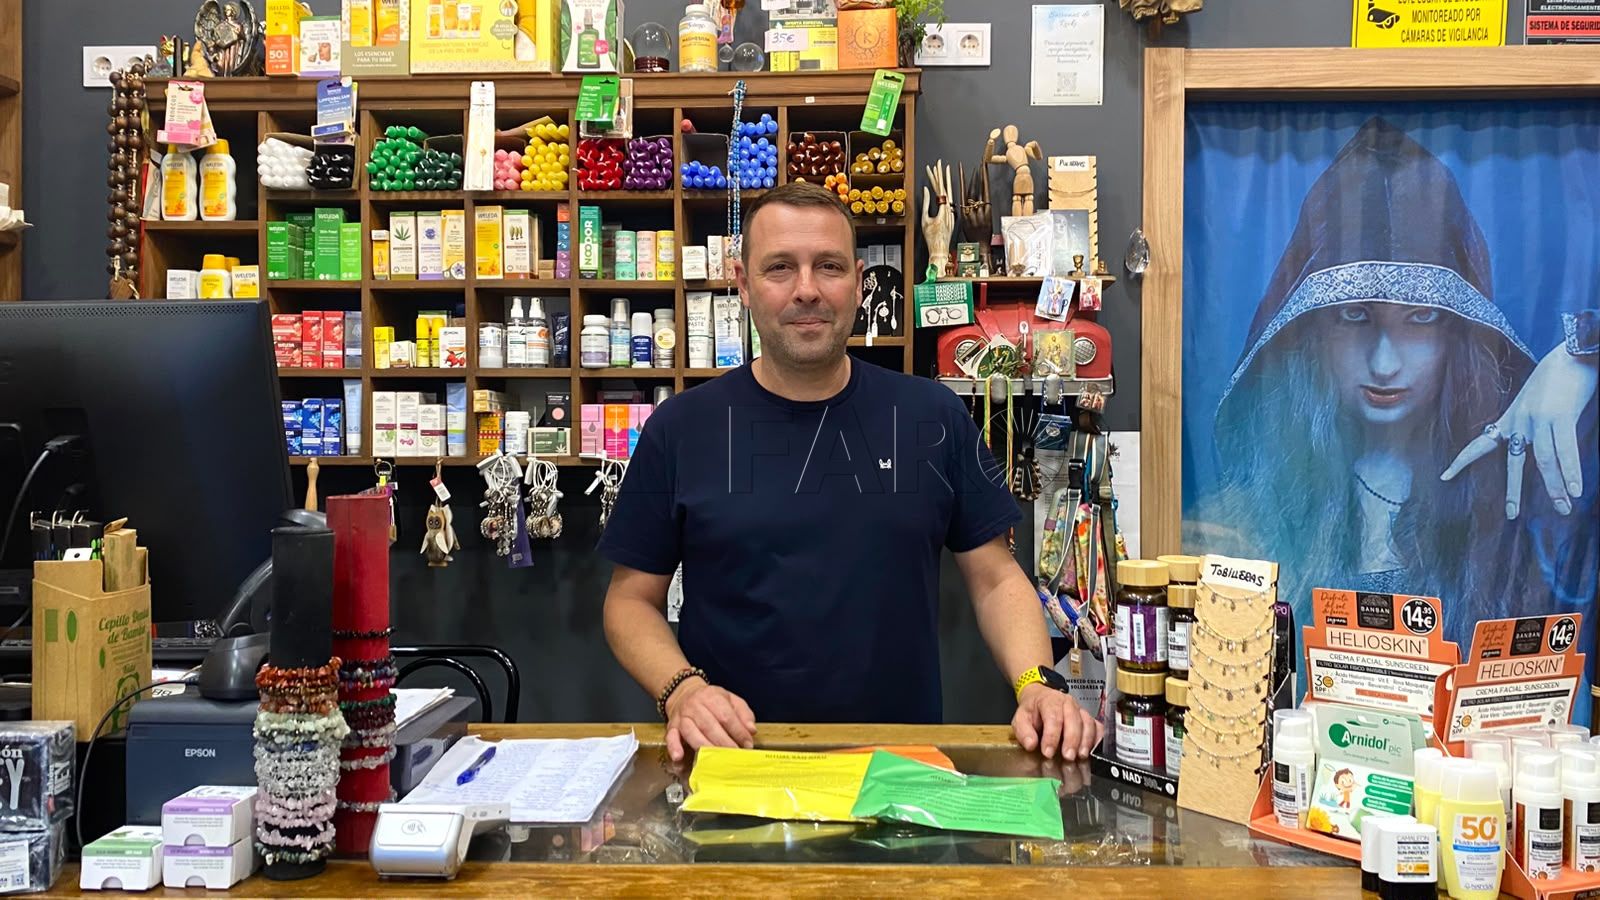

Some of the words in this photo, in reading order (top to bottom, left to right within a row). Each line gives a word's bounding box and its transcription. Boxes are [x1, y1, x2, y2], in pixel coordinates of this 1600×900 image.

[1412, 8, 1464, 23] MONITOREADO
[1466, 8, 1480, 21] POR
[1529, 20, 1558, 31] SISTEMA
[1560, 20, 1570, 30] DE
[1571, 20, 1600, 30] SEGURID
[1401, 28, 1436, 43] CÁMARAS
[1436, 28, 1446, 42] DE
[1448, 26, 1488, 42] VIGILANCIA
[1360, 606, 1390, 614] BANBAN
[98, 614, 130, 632] Cepillo
[107, 631, 118, 644] de
[1330, 631, 1422, 655] HELIOSKIN
[1329, 653, 1354, 664] CREMA
[1356, 655, 1383, 666] FACIAL
[1385, 660, 1430, 672] SUNSCREEN
[1481, 660, 1559, 680] HELIOSKIN
[1476, 687, 1498, 696] CREMA
[1499, 685, 1522, 694] FACIAL
[1524, 682, 1560, 692] SUNSCREEN
[1341, 730, 1387, 750] Arnidol
[1389, 745, 1401, 756] pic
[184, 748, 216, 757] EPSON
